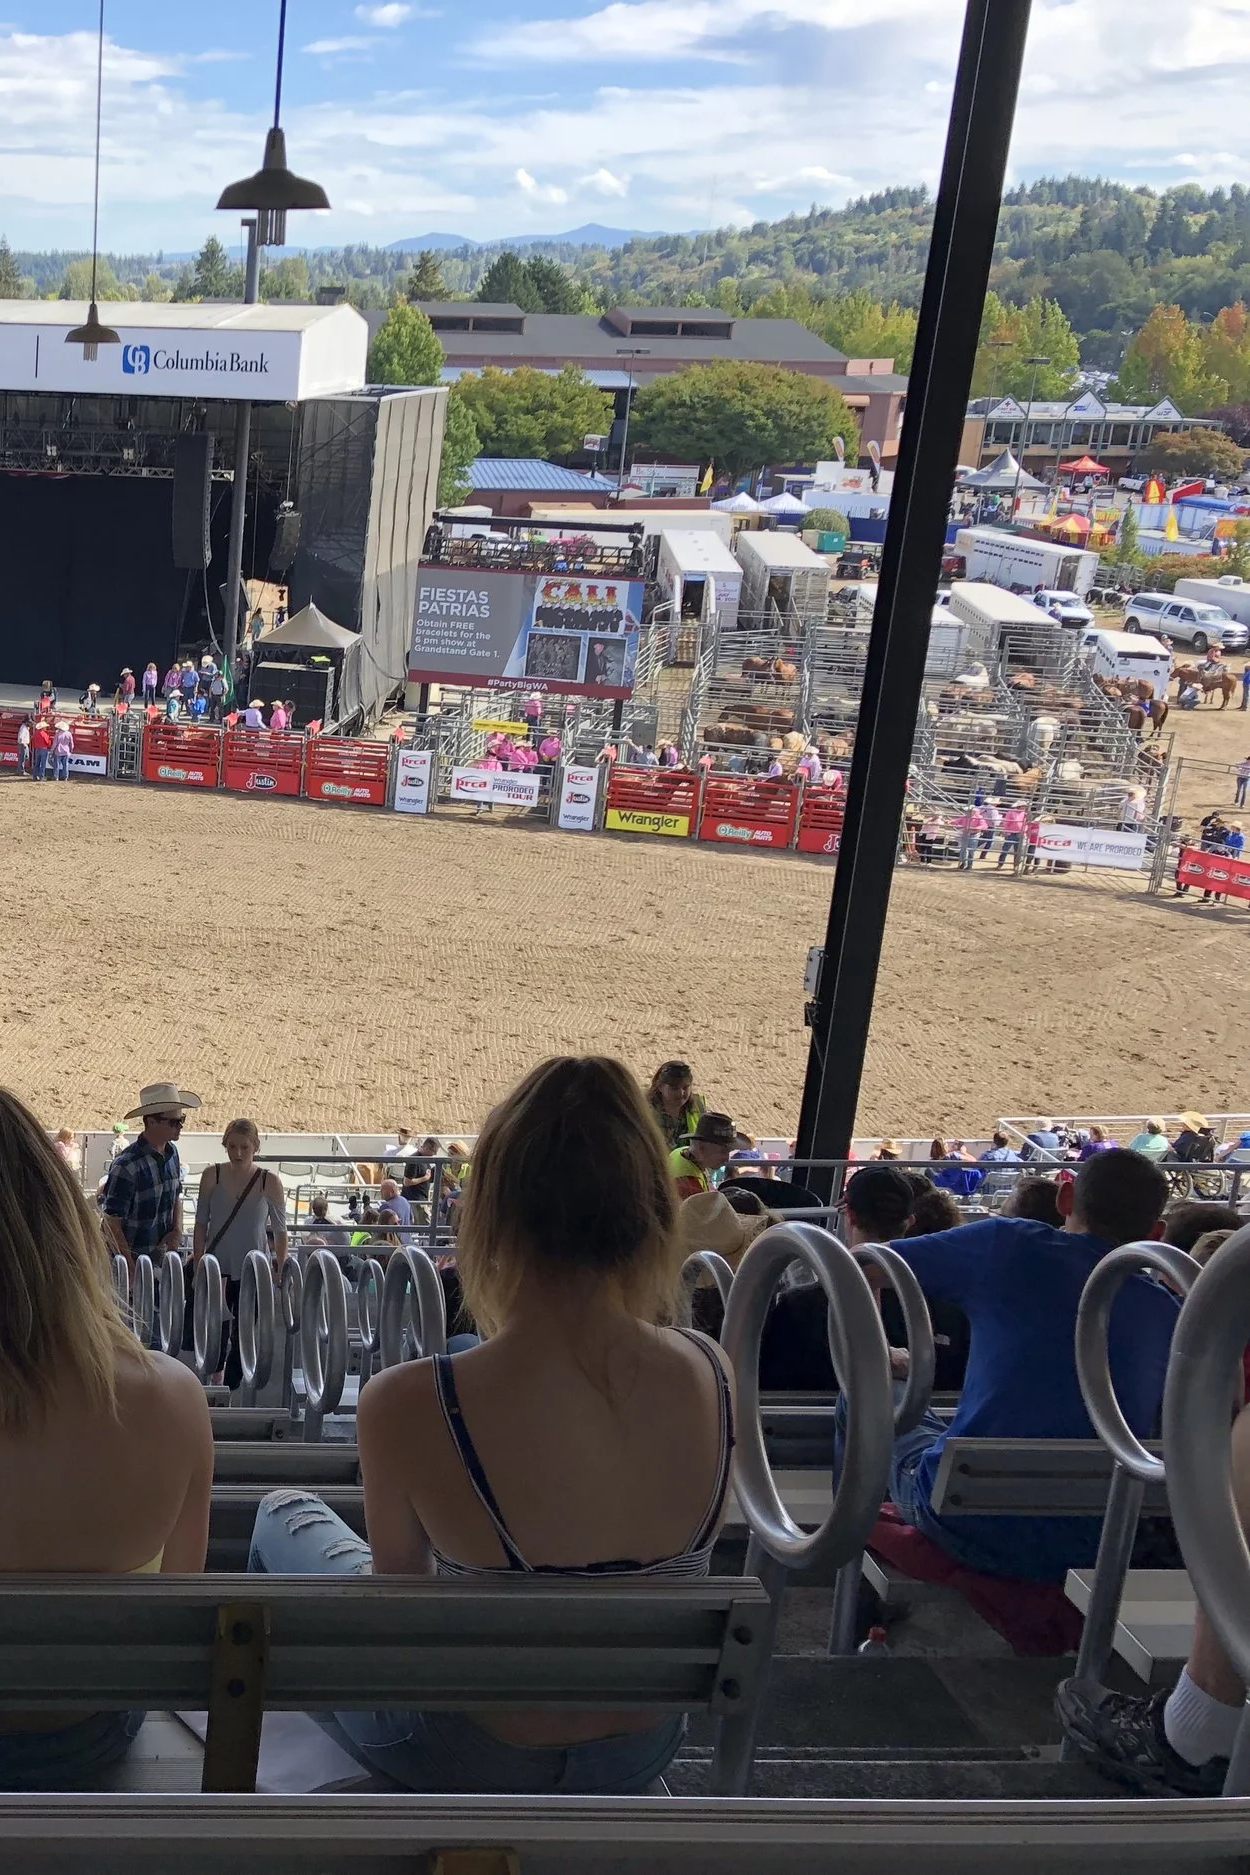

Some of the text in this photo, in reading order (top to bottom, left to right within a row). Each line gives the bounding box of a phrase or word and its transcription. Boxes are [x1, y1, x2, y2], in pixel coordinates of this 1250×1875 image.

[419, 586, 490, 605] FIESTAS
[541, 582, 618, 606] CALI
[418, 600, 491, 618] PATRIAS
[416, 619, 475, 631] Obtain FREE
[415, 627, 491, 641] bracelets for the
[414, 636, 476, 648] 6 pm show at
[414, 644, 467, 656] Grandstand
[468, 647, 491, 658] Gate
[487, 679, 549, 691] #PartyBigWA
[402, 757, 427, 767] prca
[246, 772, 276, 790] Justin
[456, 777, 488, 791] prca
[567, 773, 594, 783] prca
[492, 784, 534, 795] PRORODEO
[506, 793, 533, 801] TOUR
[617, 810, 680, 832] Wrangler
[717, 824, 751, 840] O'Reilly
[1036, 836, 1072, 848] prca
[1077, 841, 1142, 856] WE ARE PRORODEO
